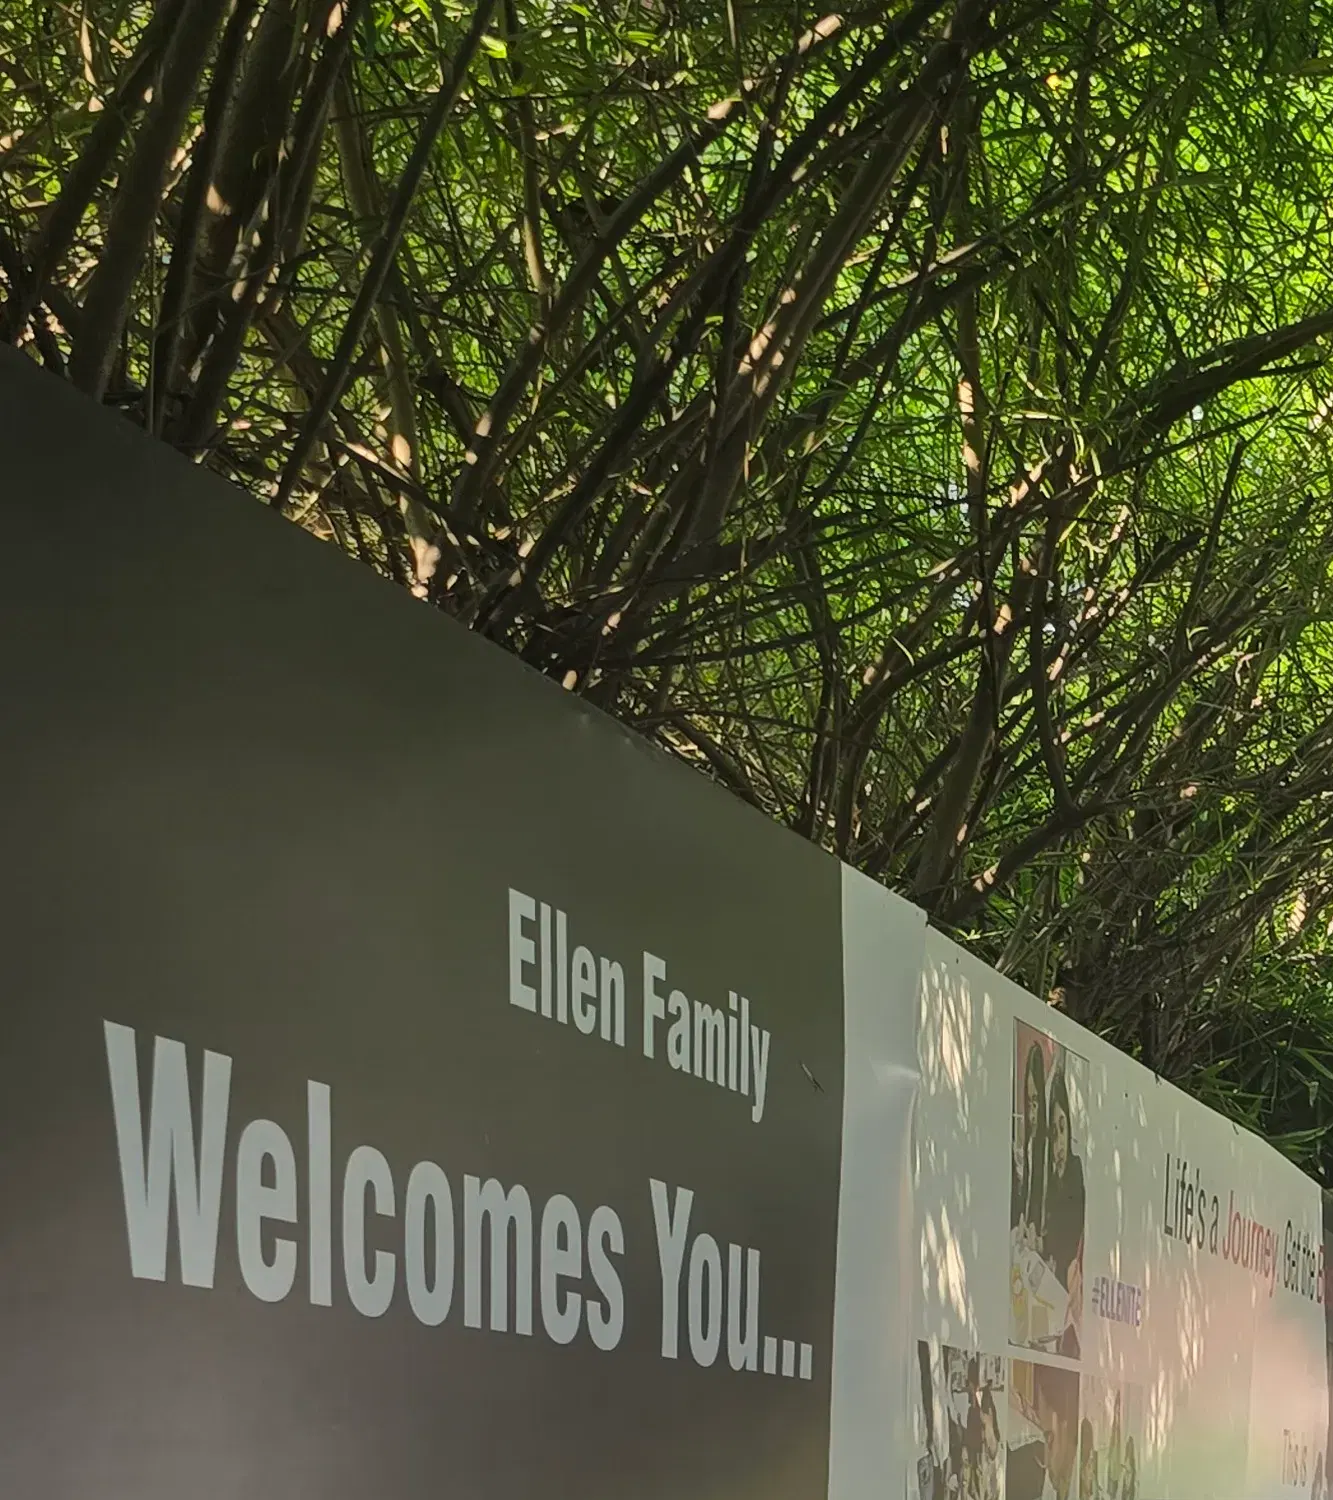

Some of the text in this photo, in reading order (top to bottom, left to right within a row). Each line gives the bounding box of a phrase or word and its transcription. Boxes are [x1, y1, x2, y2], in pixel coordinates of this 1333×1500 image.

[508, 887, 771, 1124] Ellen Family
[103, 1019, 813, 1380] Welcomes You...
[1163, 1152, 1207, 1250] Life's
[1210, 1195, 1220, 1256] a
